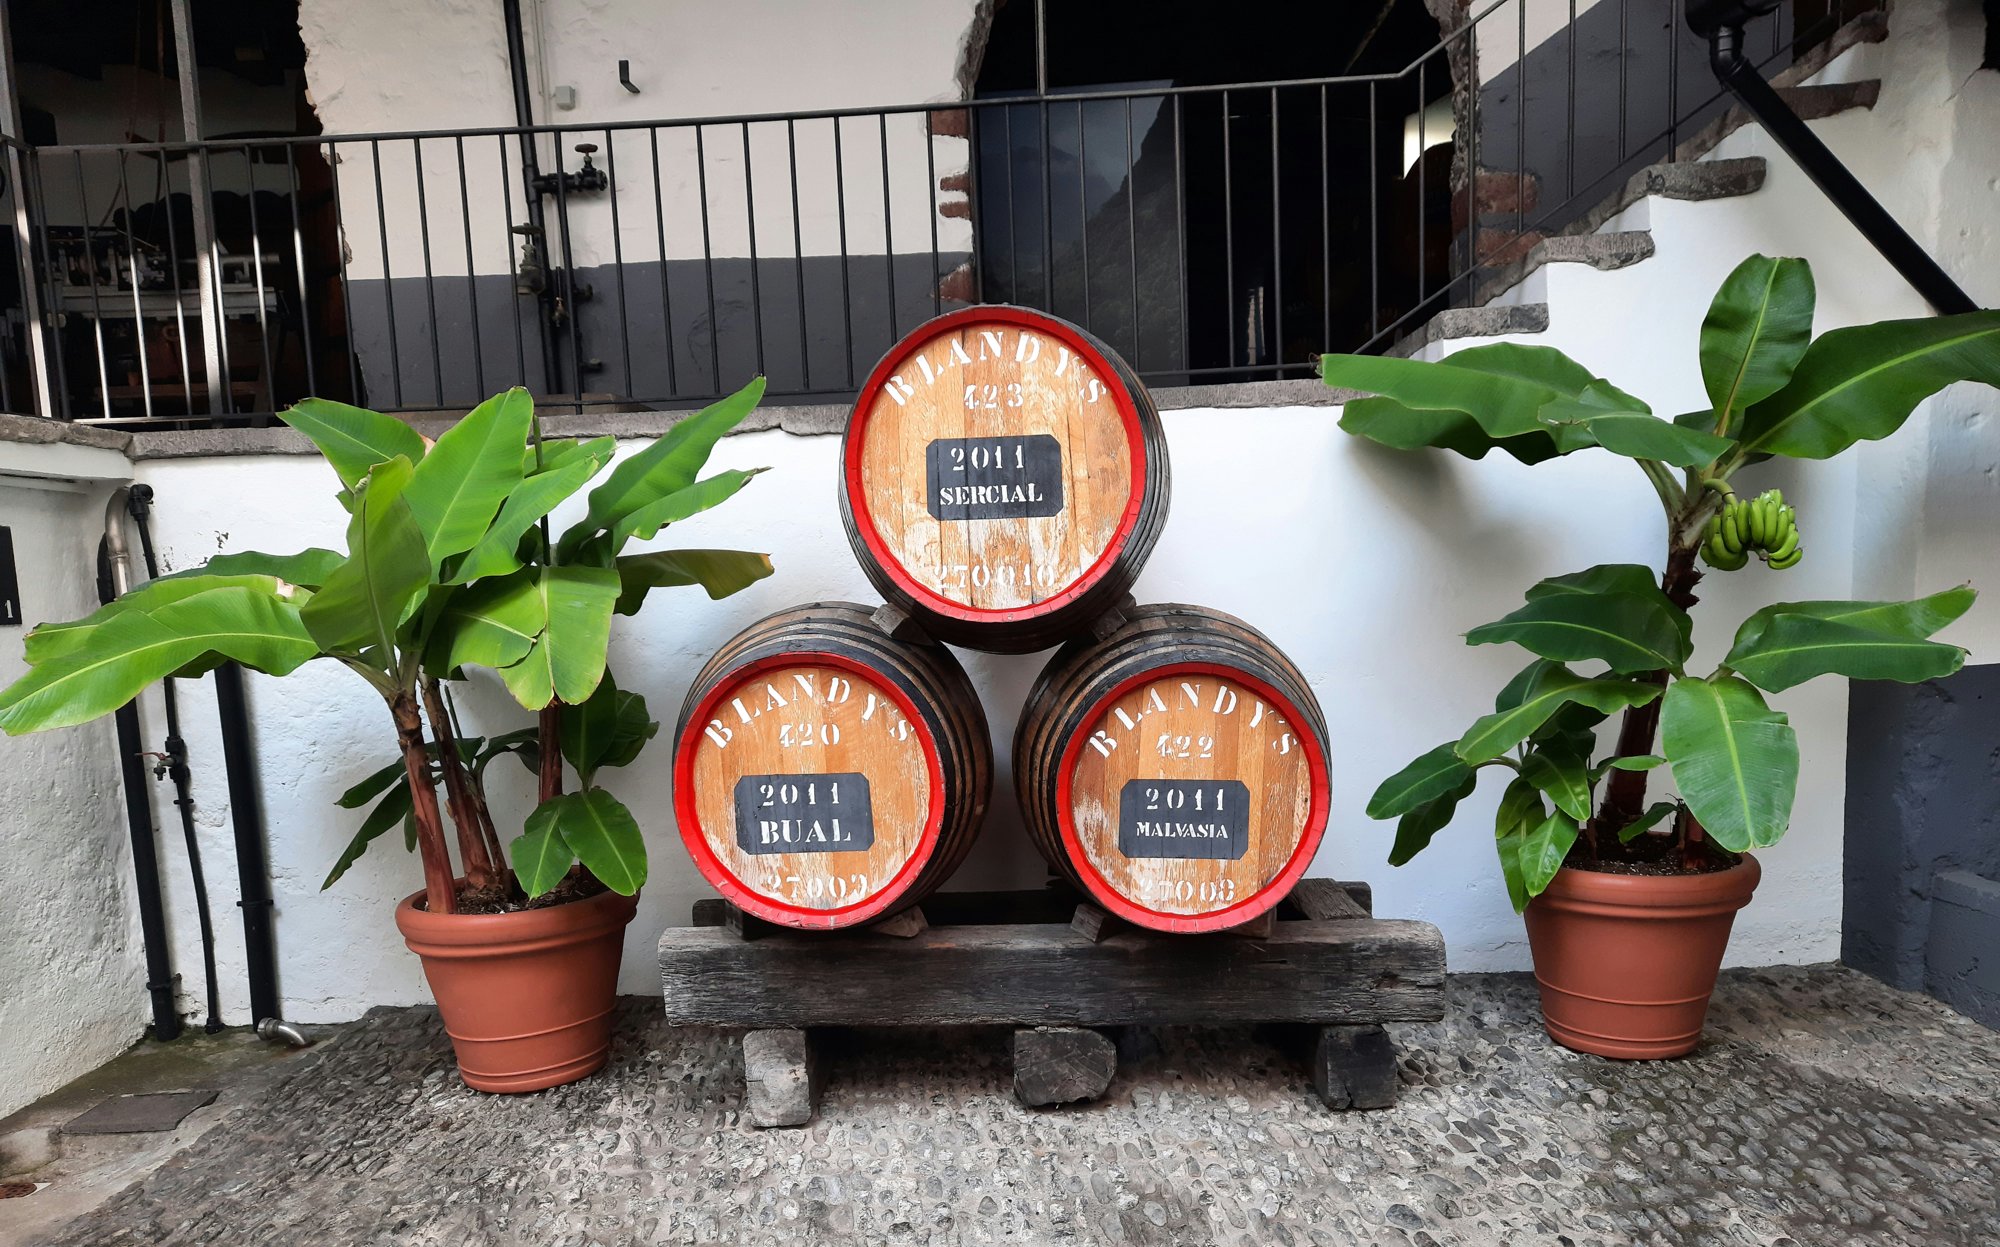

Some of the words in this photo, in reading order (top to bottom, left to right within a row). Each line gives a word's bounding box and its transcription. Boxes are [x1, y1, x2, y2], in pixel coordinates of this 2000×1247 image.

[964, 384, 1024, 409] 423
[950, 445, 1025, 471] 2011
[940, 483, 1043, 506] SERCIAL
[780, 723, 840, 748] 420
[1156, 734, 1214, 758] 422
[759, 782, 840, 807] 2011
[1145, 788, 1224, 811] 2011
[760, 819, 851, 844] BUAL
[1136, 821, 1228, 839] MALVASIA
